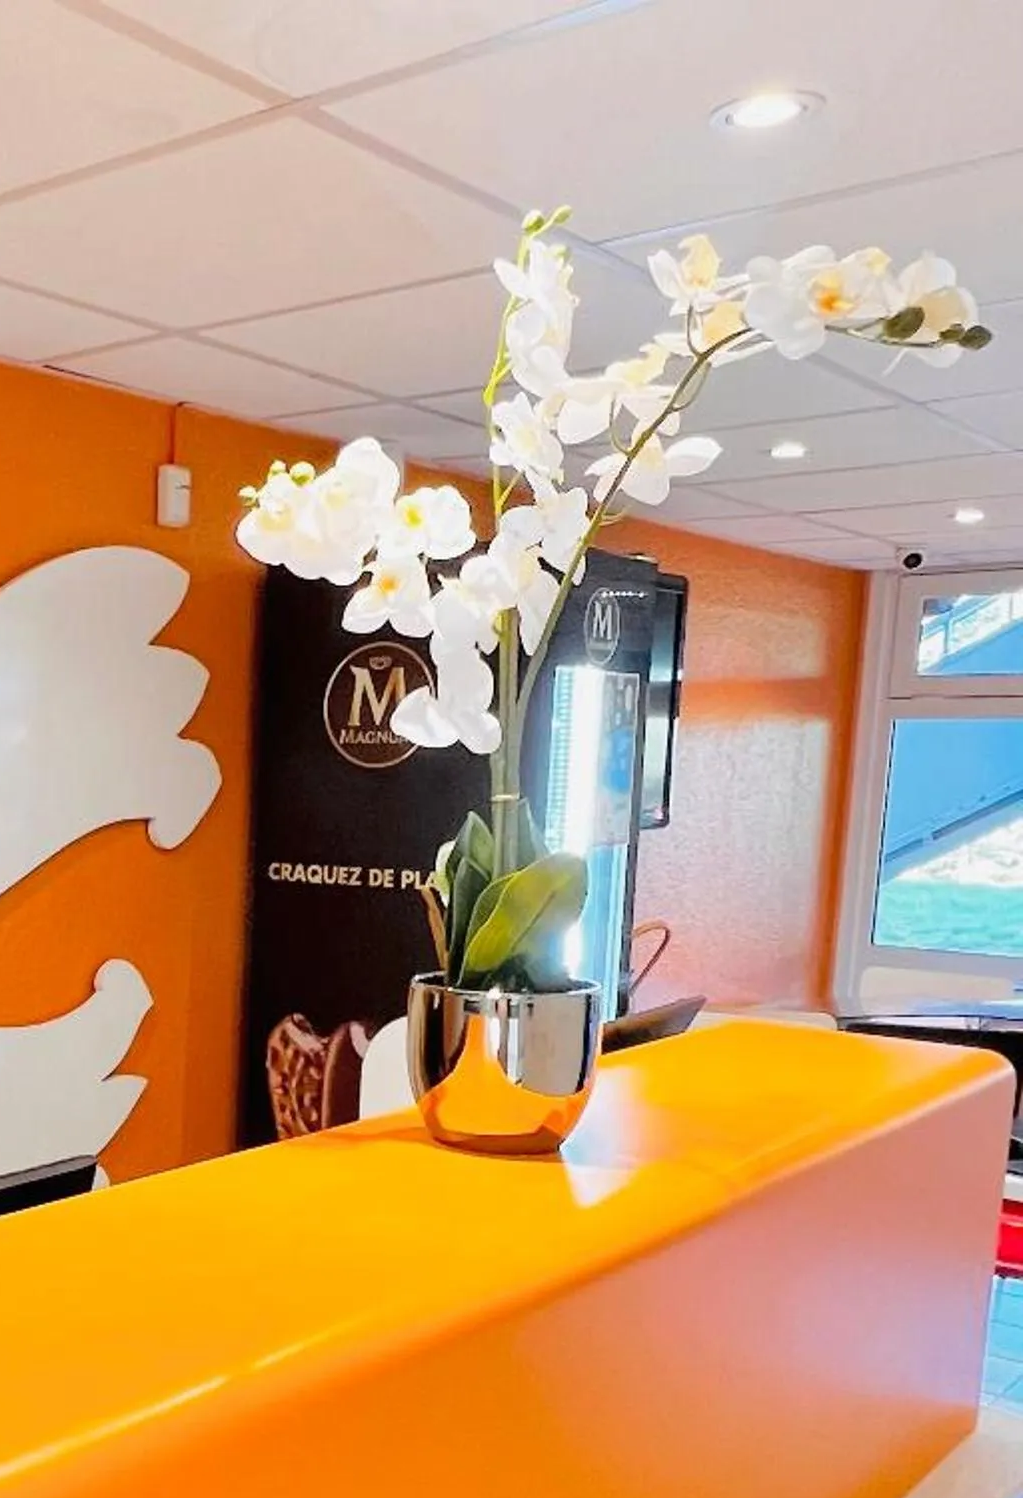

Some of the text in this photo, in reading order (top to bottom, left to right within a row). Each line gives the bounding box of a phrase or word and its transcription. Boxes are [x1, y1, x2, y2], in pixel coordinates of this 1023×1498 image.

[594, 600, 613, 640] M
[339, 729, 409, 744] MAGNU
[268, 862, 437, 890] CRAQUEZ DE PLA
